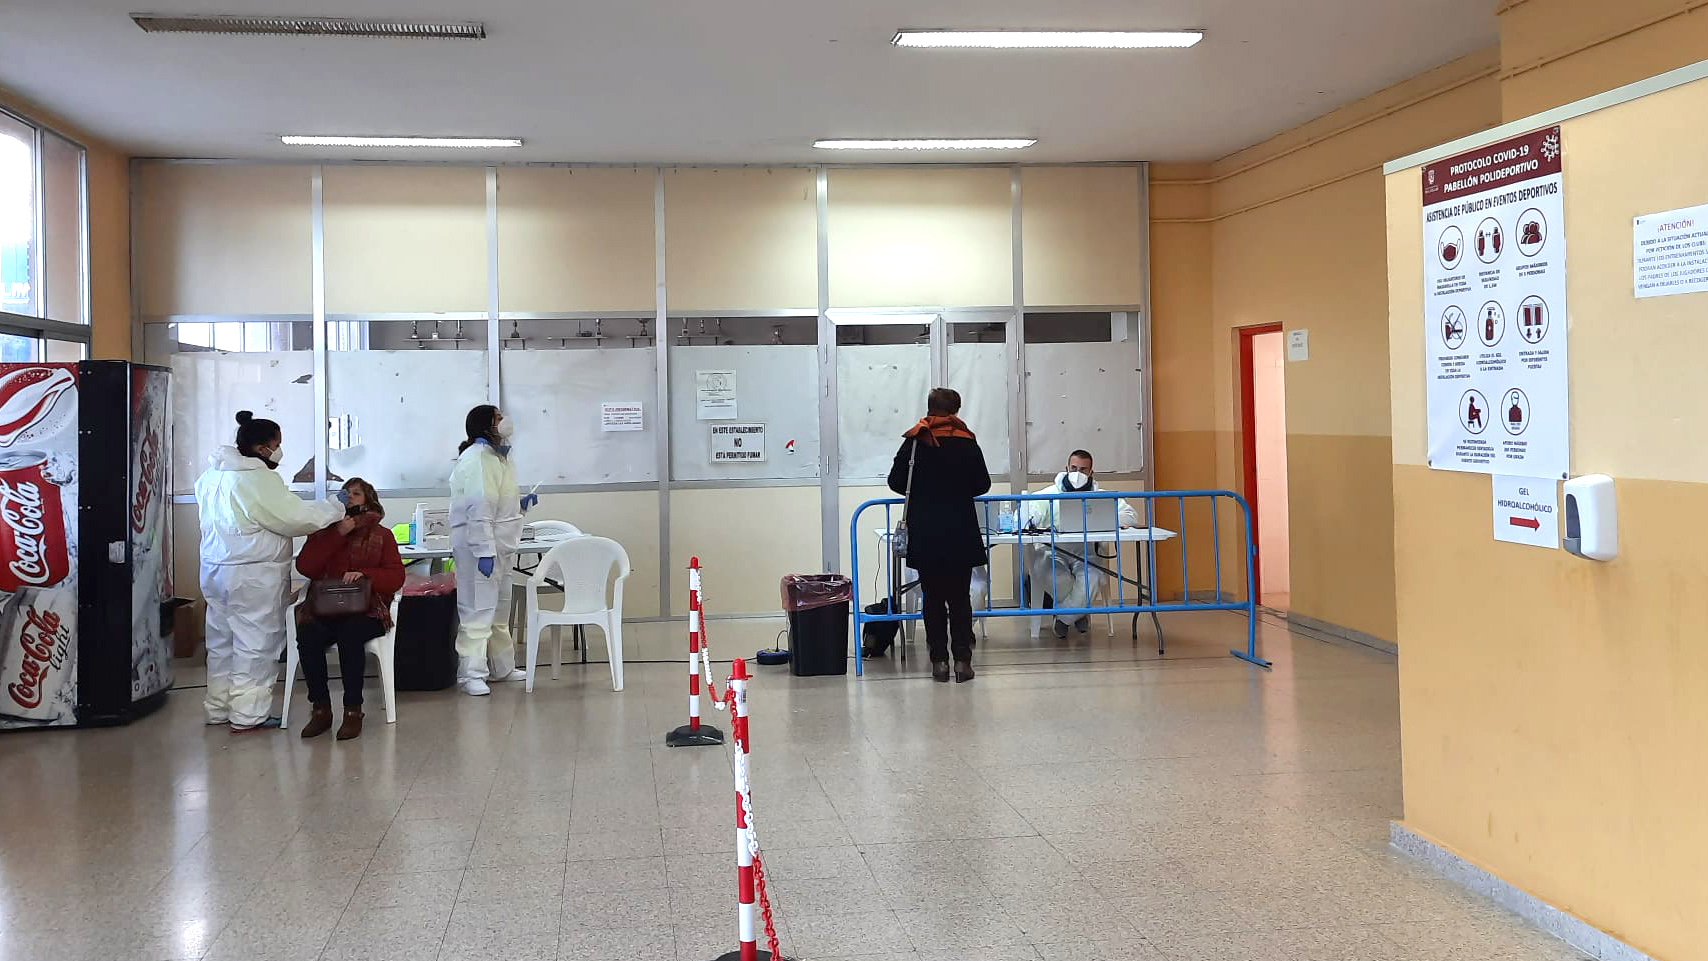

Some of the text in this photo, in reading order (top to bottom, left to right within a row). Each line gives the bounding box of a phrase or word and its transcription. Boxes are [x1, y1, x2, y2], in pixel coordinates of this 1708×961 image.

[1450, 145, 1529, 176] PROTOCOLO COVID-19
[1444, 175, 1479, 193] PABELLÓN
[1480, 159, 1538, 184] POLIDEPORTIVO
[1427, 182, 1558, 223] ASISTENCIA DE PÚBLICO EN EVENTOS DEPORTIVOS
[734, 438, 743, 448] NO
[1519, 488, 1529, 496] GEL
[1498, 500, 1553, 514] HIDROALCOHÓLICO
